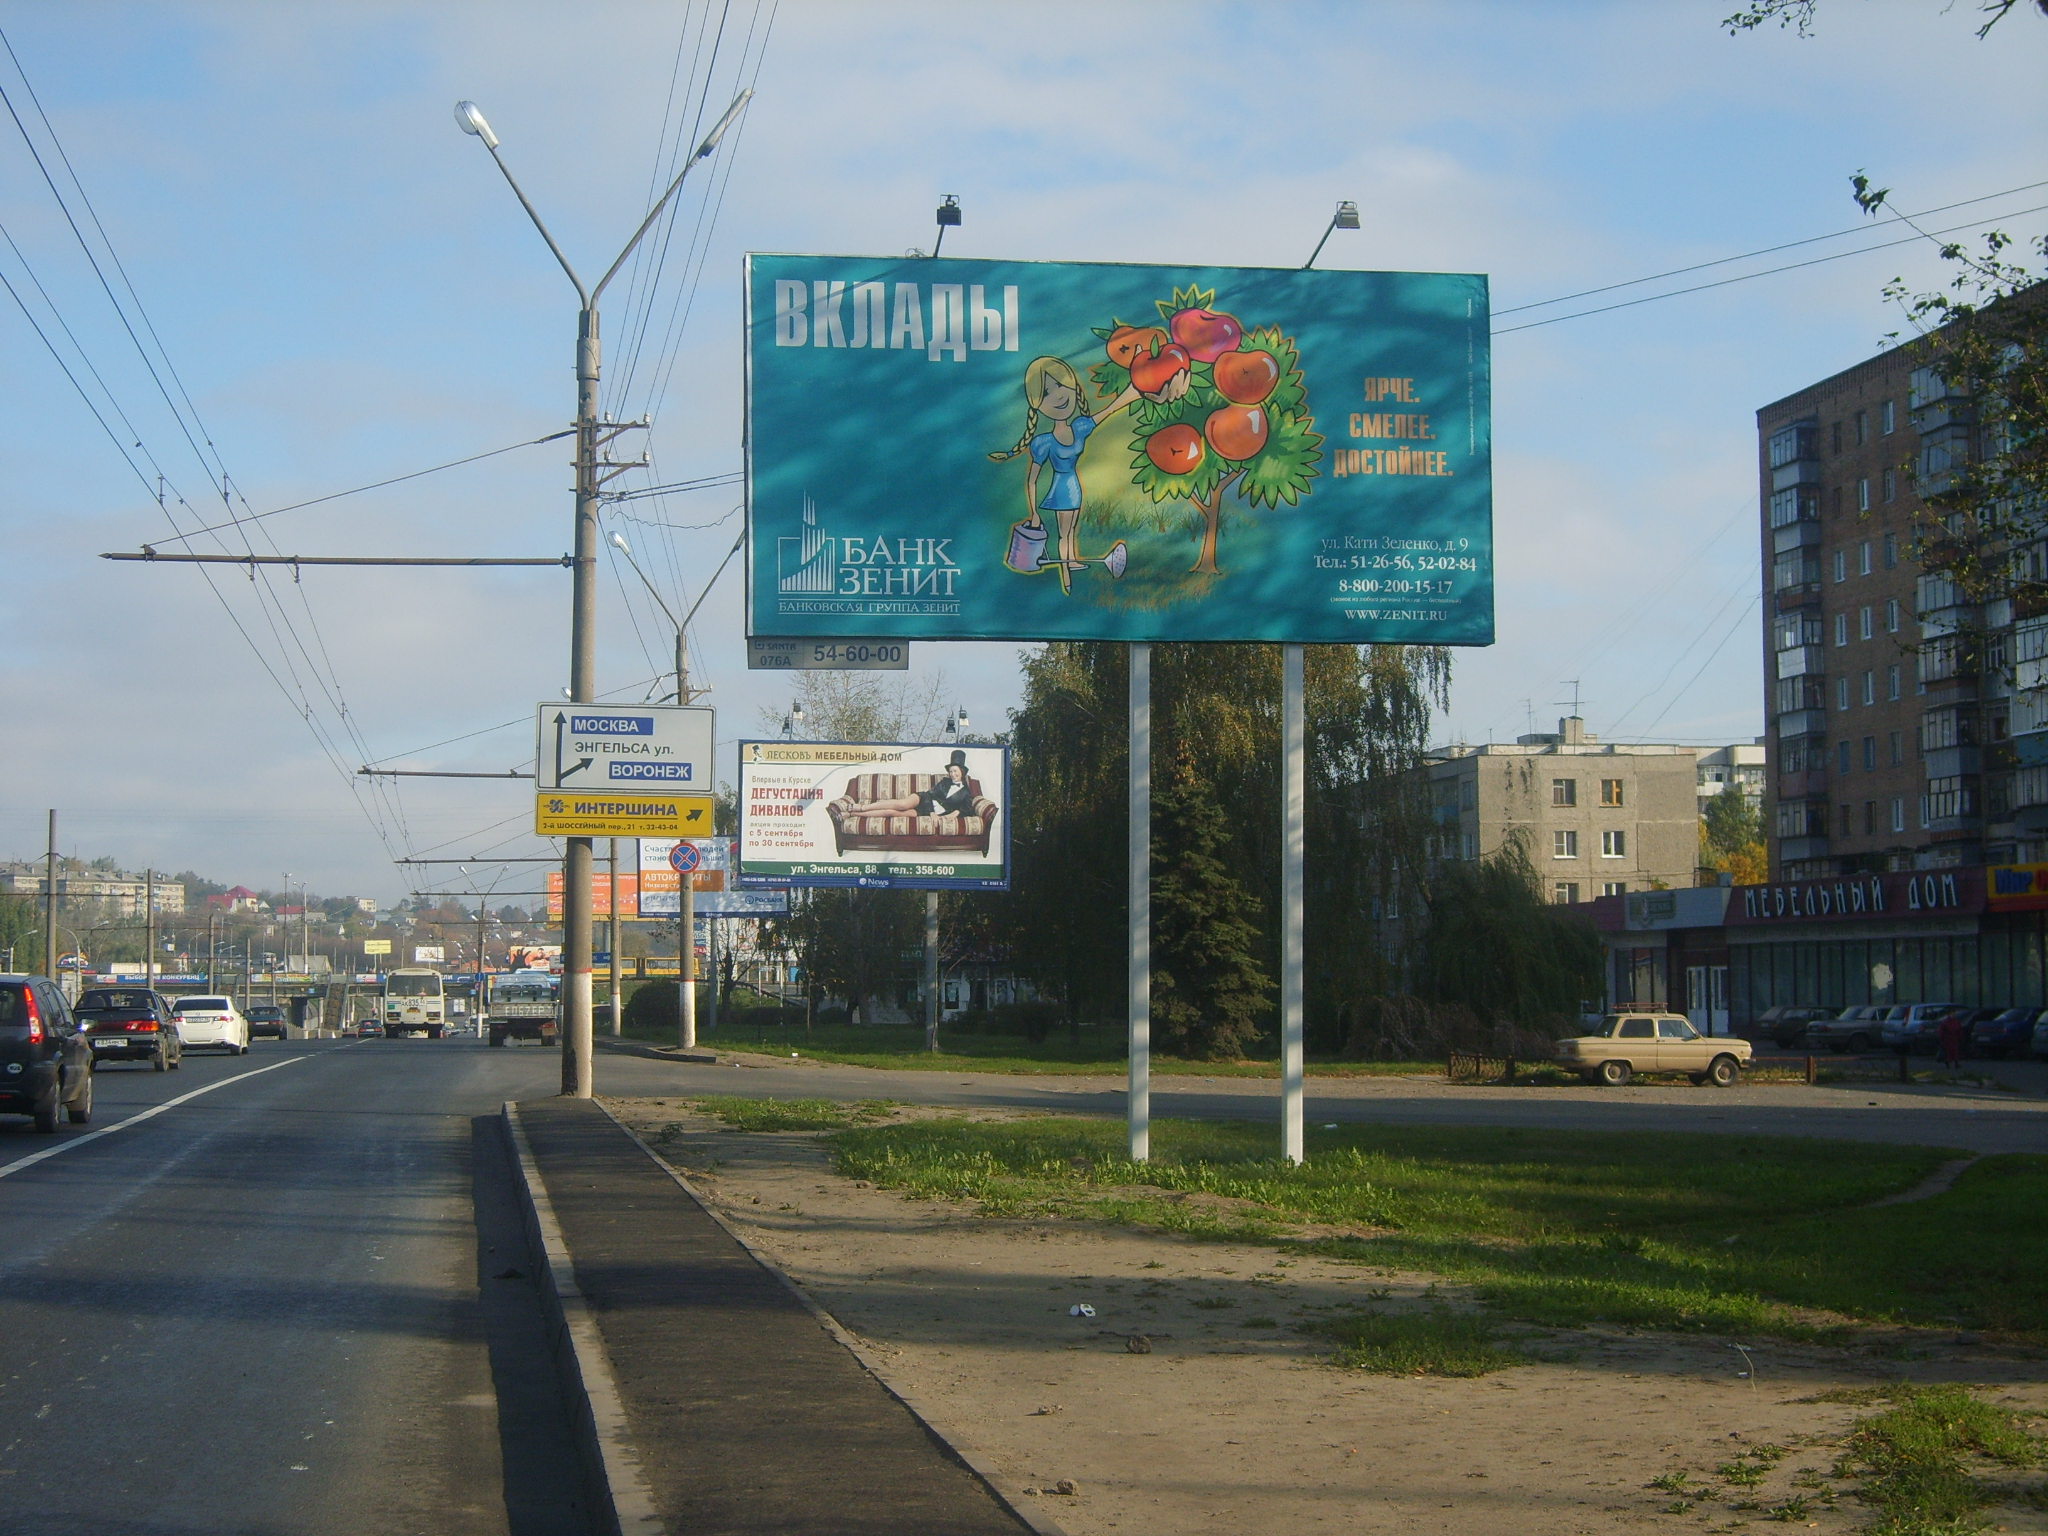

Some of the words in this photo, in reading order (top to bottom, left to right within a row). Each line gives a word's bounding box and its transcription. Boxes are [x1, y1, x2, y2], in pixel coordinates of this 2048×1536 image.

[775, 279, 1019, 362] ВКЛАДЫ
[1364, 377, 1421, 403] ЯРЧЕ.
[1349, 413, 1437, 439] СМЕЛЕЕ.
[1333, 446, 1454, 478] ДОСТОЙНЕЕ.
[841, 535, 956, 565] БАНК
[1321, 539, 1340, 553] ул.
[1344, 536, 1377, 549] Кати
[1381, 536, 1441, 553] Зеленко,
[1445, 540, 1456, 552] д.
[1459, 538, 1468, 552] 9
[1314, 556, 1347, 569] Тел.:
[1350, 554, 1414, 571] 51-26-56,
[1418, 556, 1477, 572] 52-02-84
[839, 567, 961, 596] ЗЕНИТ
[1339, 579, 1453, 595] 8-800-200-15-17
[779, 602, 863, 612] БАНКОВСКАЯ
[869, 602, 919, 613] ГРУППА
[922, 604, 961, 614] ЗЕНИТ
[1344, 609, 1447, 621] WWW.ZENIT.RU
[814, 645, 901, 662] 54-60-00
[574, 719, 639, 733] МОСКВА
[574, 741, 650, 754] ЭНГЕЛЬСА
[654, 744, 674, 757] ул.
[815, 750, 877, 761] МЕБЕЛЬНЫЙ
[880, 753, 902, 763] ДОМ
[611, 764, 690, 778] ВОРОНЕЖ
[752, 775, 781, 784] Впервые
[788, 776, 812, 785] Курске
[751, 787, 824, 800] ДЕГУСТАЦИЯ
[574, 802, 678, 816] ИНТЕРШИНА
[750, 804, 804, 817] ДИВАНОВ
[557, 822, 606, 830] ШОССЕЙНЫЙ
[756, 829, 762, 837] 5
[764, 829, 804, 838] сентября
[775, 840, 815, 849] сентября
[791, 865, 807, 875] ул.
[809, 864, 862, 875] Энгельса,
[864, 865, 880, 875] 88,
[888, 867, 913, 875] тел.:
[915, 865, 955, 876] 358-600
[1745, 876, 1883, 919] МЕБЕЛЬНЫЙ
[1908, 873, 1957, 909] ДОМ
